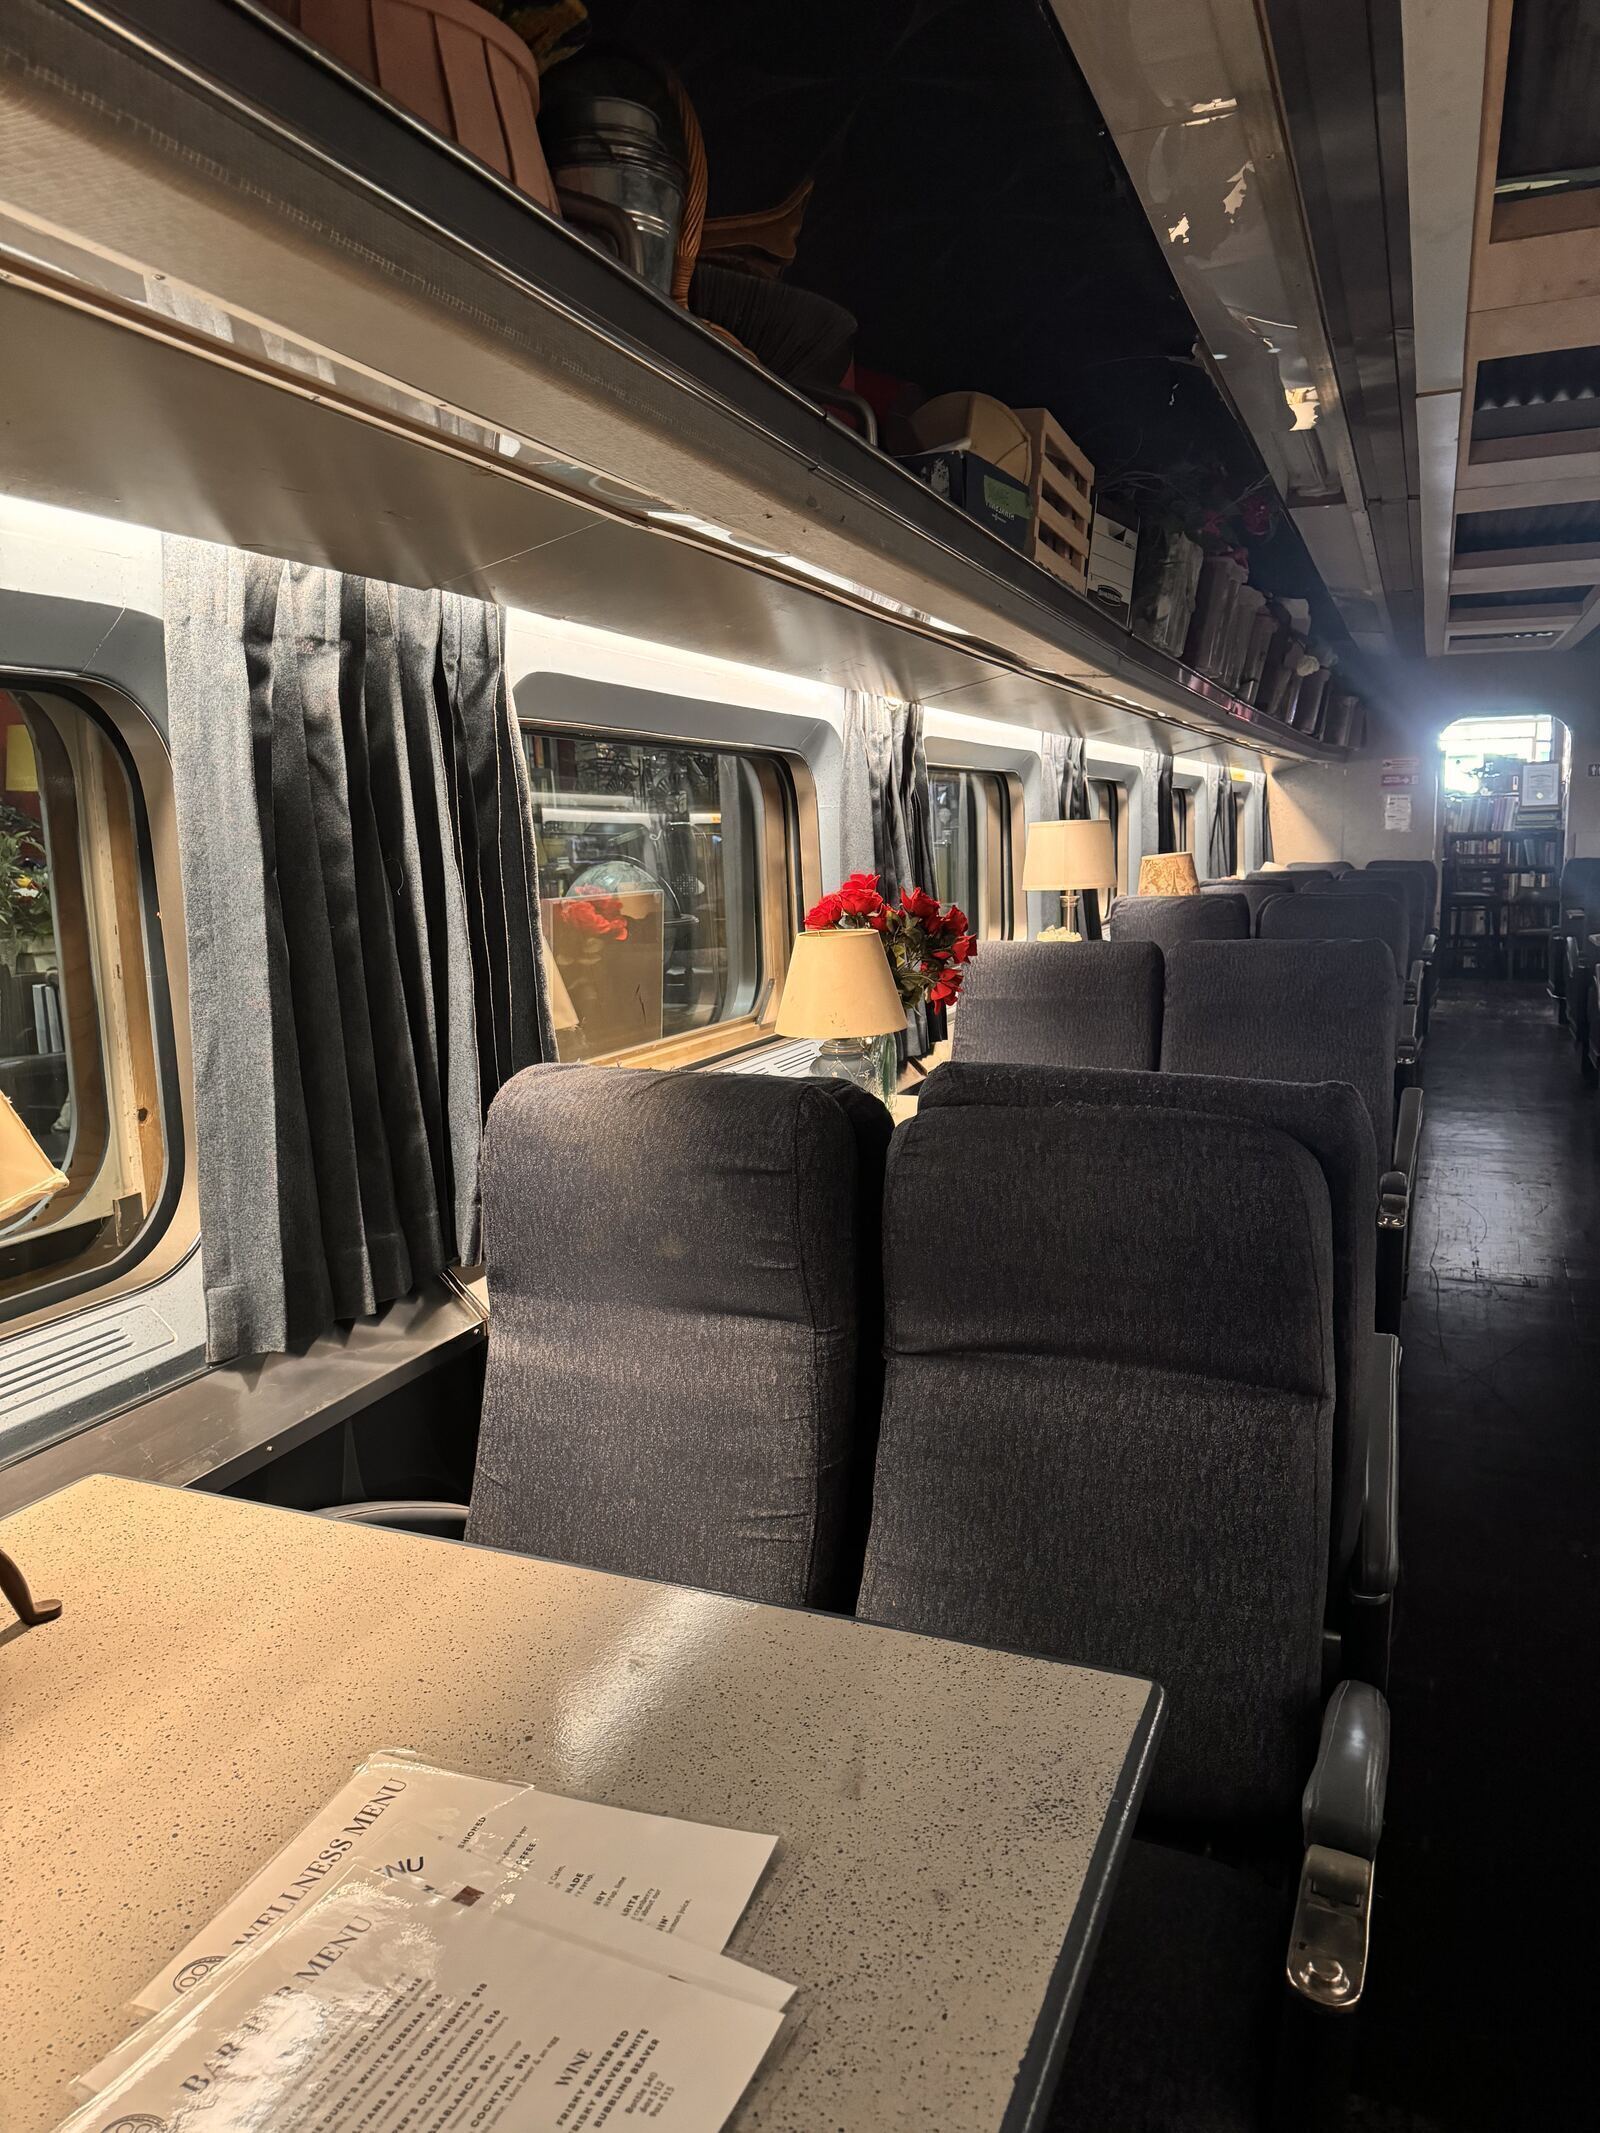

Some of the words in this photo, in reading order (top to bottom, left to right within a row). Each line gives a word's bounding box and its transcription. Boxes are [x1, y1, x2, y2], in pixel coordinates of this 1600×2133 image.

[233, 1837, 353, 1946] WELLNESS
[343, 1777, 406, 1837] MENU
[374, 1855, 424, 1879] NU
[179, 2039, 243, 2094] BAR
[294, 1915, 372, 1982] MENU
[393, 2063, 416, 2087] NEW
[413, 2036, 440, 2062] YORK
[438, 2000, 471, 2034] NIGHTS
[322, 2086, 359, 2123] DUDE'S
[356, 2051, 389, 2084] WHITE
[387, 2010, 426, 2051] RUSSIAN
[424, 1992, 443, 2008] $16
[329, 2034, 369, 2075] STIRRED
[417, 2083, 438, 2105] OLD
[435, 2027, 484, 2082] FASHIONED
[483, 2008, 500, 2024] $16
[469, 2073, 514, 2127] COCKTAIL
[513, 2052, 531, 2069] $16
[478, 2054, 496, 2070] $16
[553, 2047, 592, 2084] WINE
[555, 2087, 586, 2125] FRISKY
[583, 2048, 615, 2085] BEAVER
[611, 2029, 629, 2047] RED
[593, 2074, 633, 2127] BUBBLING
[629, 2037, 660, 2074] BEAVER
[595, 2059, 626, 2096] BEAVER
[623, 2028, 649, 2057] WHITE
[624, 2087, 647, 2112] Bottle
